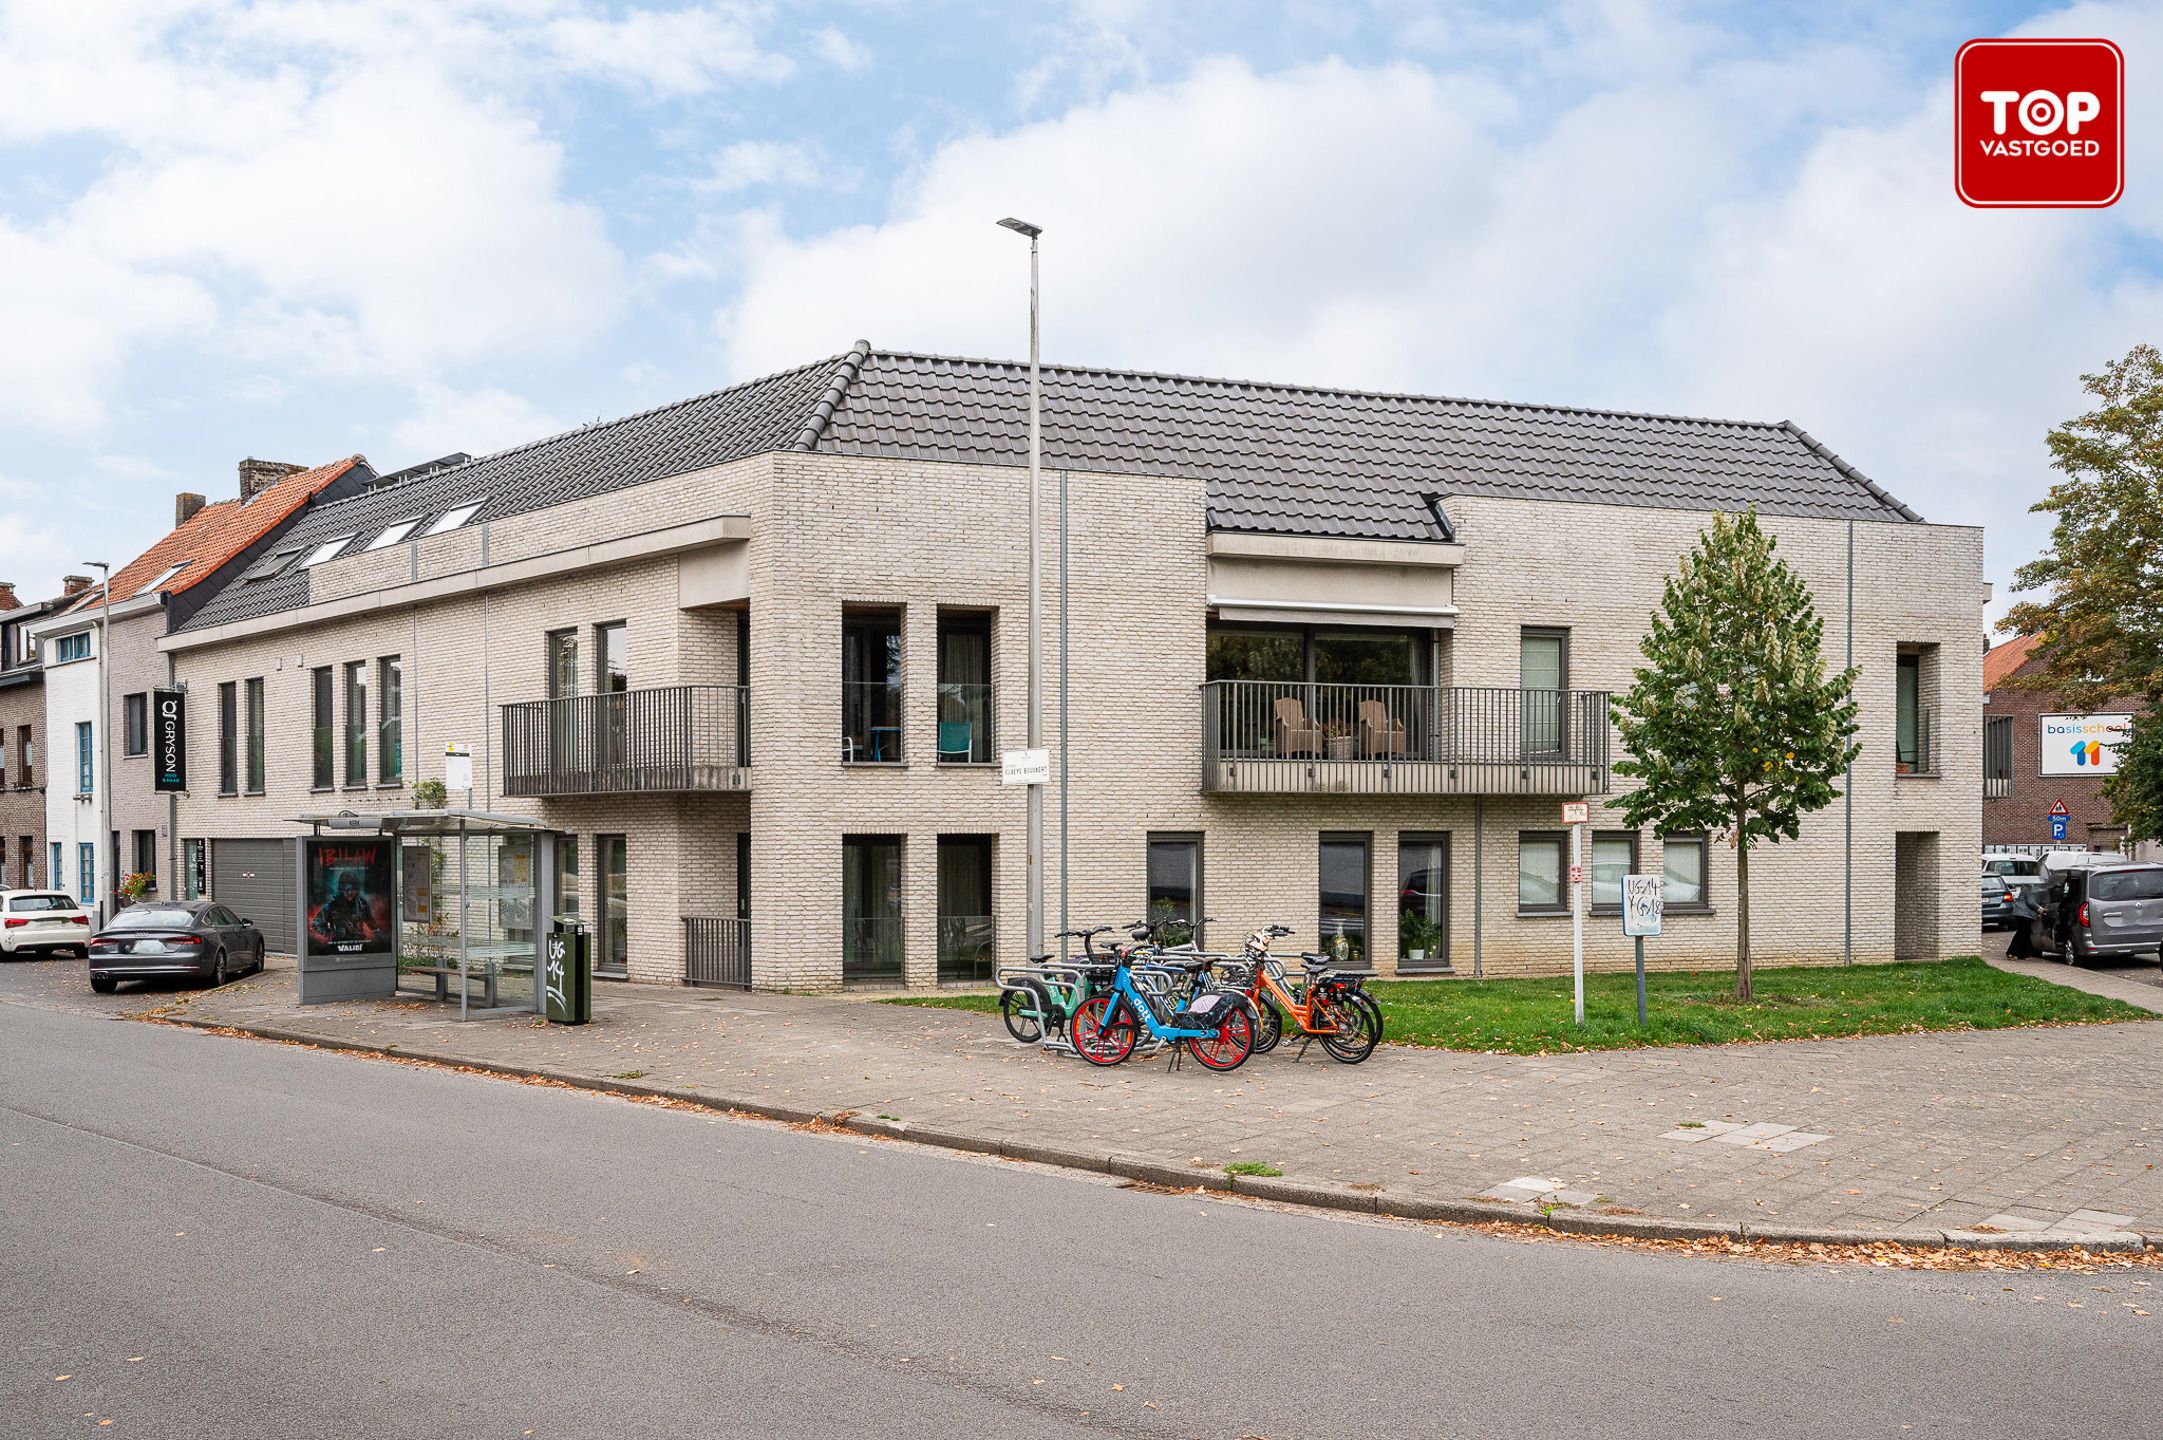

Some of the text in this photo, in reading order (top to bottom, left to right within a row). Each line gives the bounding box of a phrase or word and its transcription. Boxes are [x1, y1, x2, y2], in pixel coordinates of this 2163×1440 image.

[2047, 723, 2126, 734] basisschool
[165, 721, 176, 772] GRYSON
[2053, 824, 2063, 836] P
[1133, 998, 1151, 1023] dott
